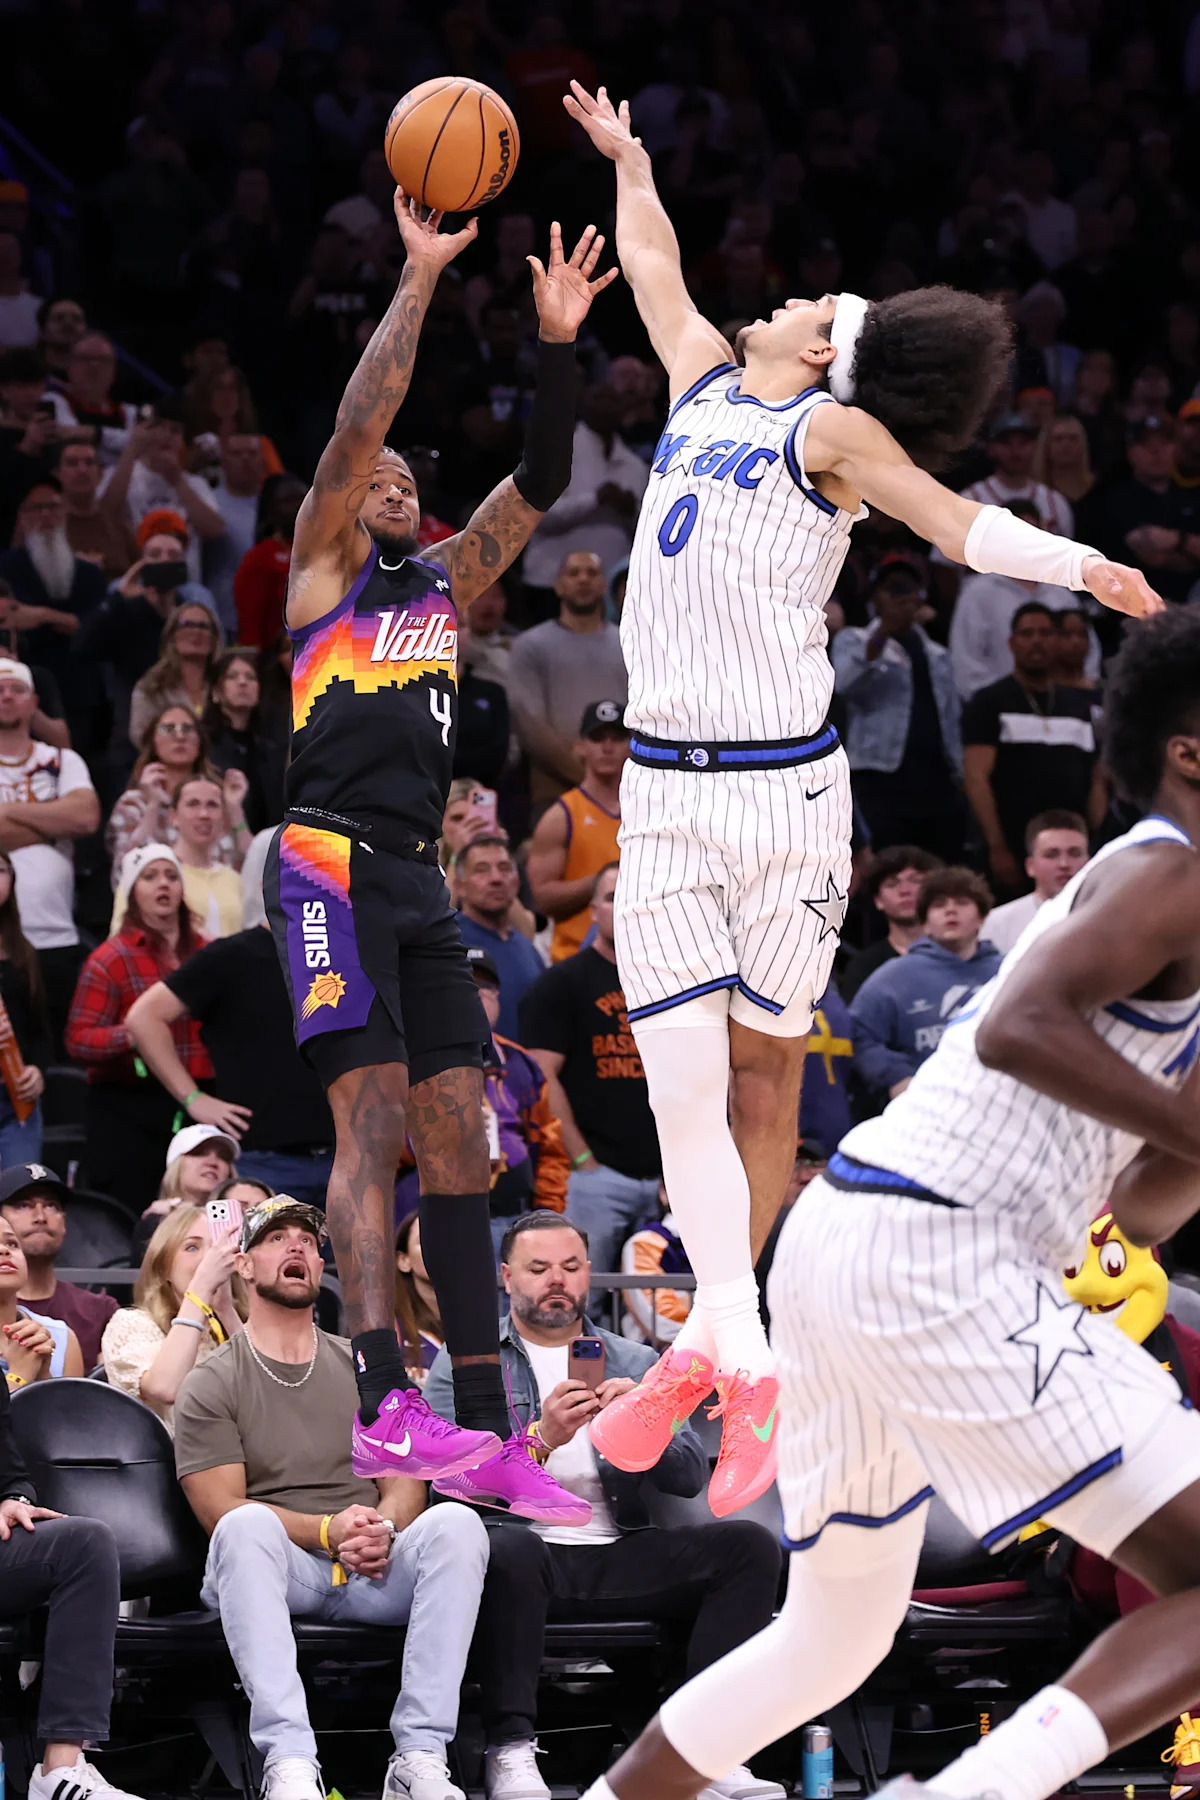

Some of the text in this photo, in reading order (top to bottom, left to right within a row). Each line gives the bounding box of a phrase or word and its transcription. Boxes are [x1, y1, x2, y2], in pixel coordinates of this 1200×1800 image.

[657, 493, 699, 557] 0
[407, 616, 428, 627] THE
[428, 686, 453, 747] 4
[302, 900, 331, 968] SUNS
[595, 990, 627, 1017] PH
[596, 1056, 647, 1079] SINC
